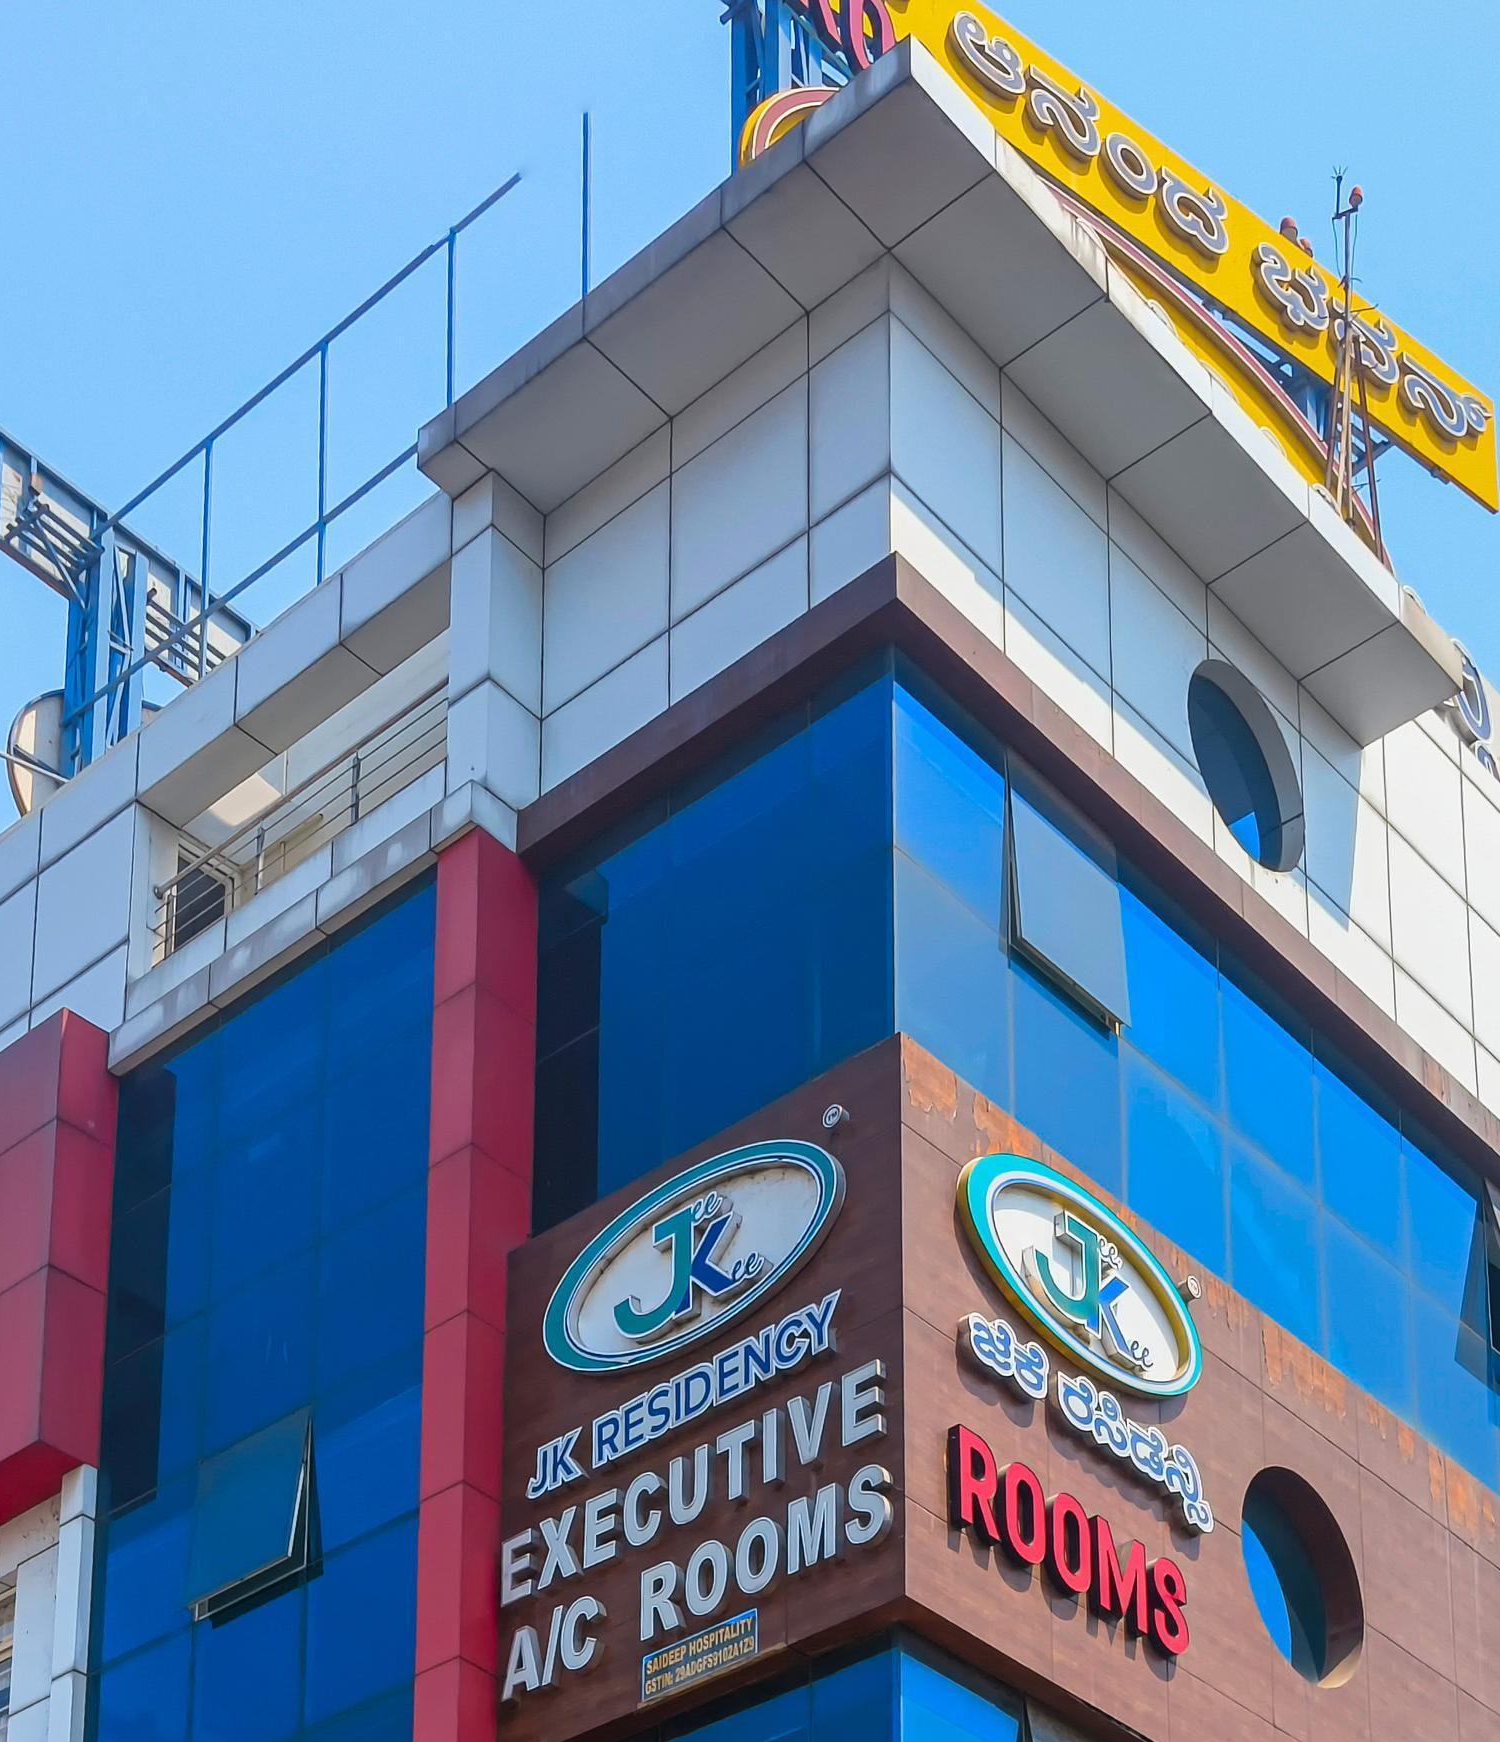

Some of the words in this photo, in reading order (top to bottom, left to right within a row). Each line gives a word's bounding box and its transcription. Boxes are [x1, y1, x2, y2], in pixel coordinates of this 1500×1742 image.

[949, 11, 1229, 257] ಆನಂದ
[501, 1359, 886, 1606] EXECUTIVE
[527, 1426, 583, 1499] JK
[592, 1289, 840, 1468] RESIDENCY
[502, 1597, 604, 1700] A/C
[640, 1464, 893, 1640] ROOMS
[646, 1645, 687, 1675] SAIDEEP
[689, 1616, 753, 1656] HOSPITALITY
[949, 1424, 1189, 1656] ROOMS
[645, 1671, 674, 1694] GSTIN:
